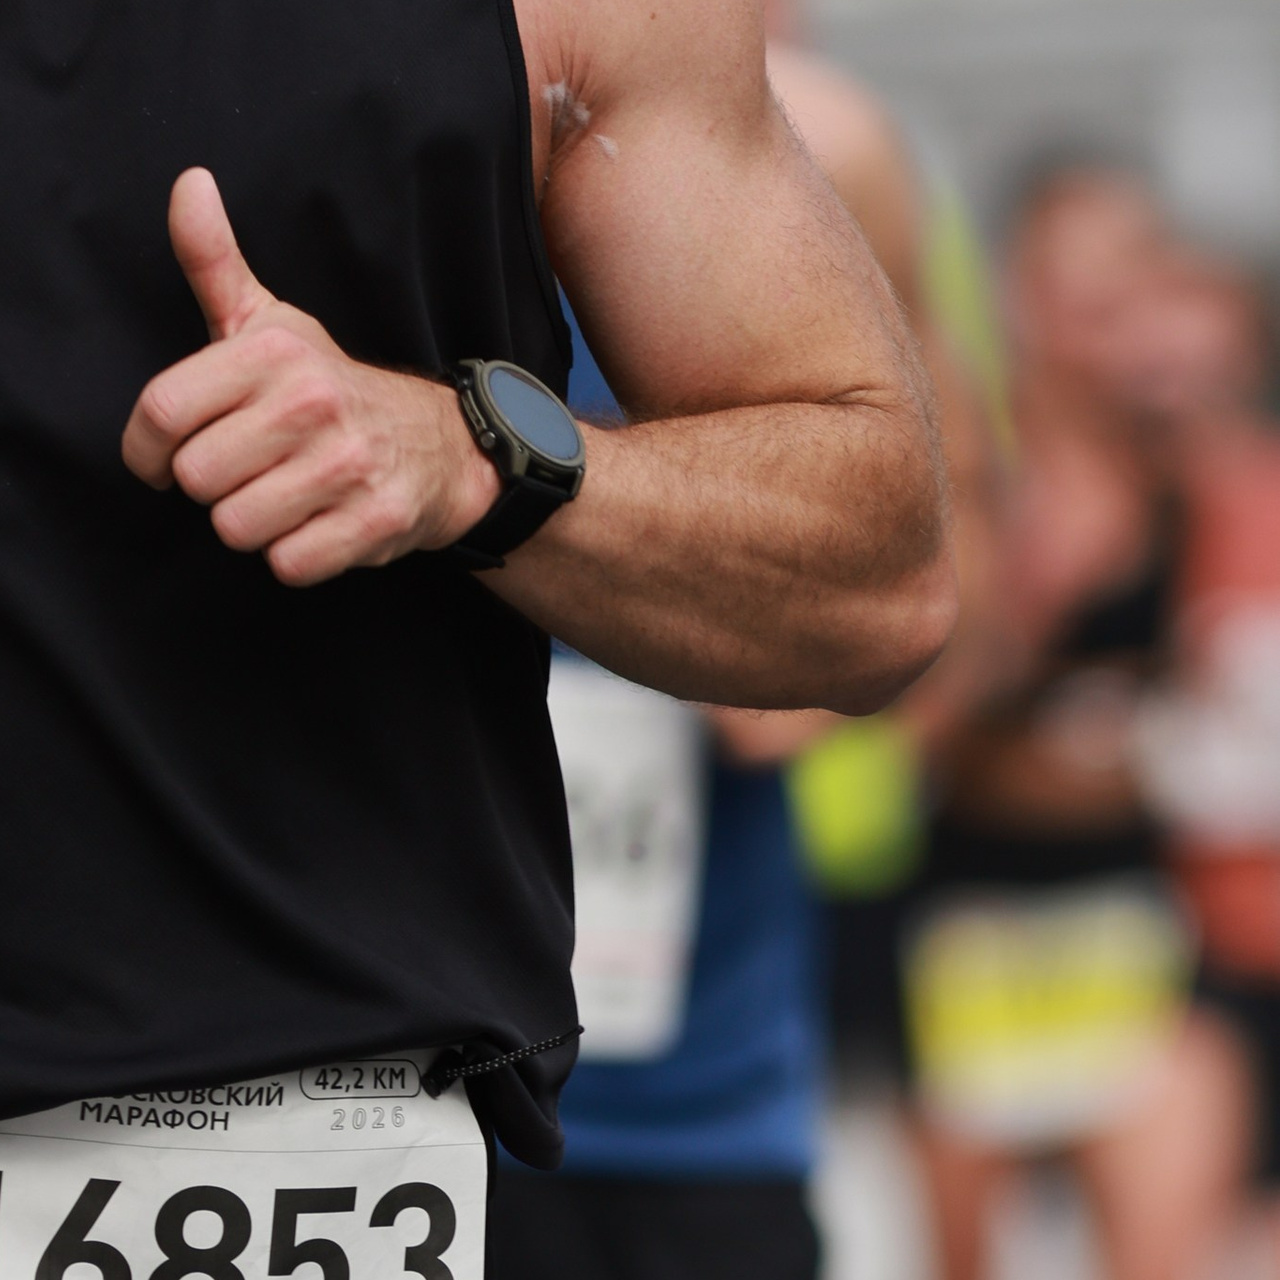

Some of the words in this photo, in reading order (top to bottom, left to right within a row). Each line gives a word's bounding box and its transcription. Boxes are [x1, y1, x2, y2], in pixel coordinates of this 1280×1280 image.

[314, 1068, 364, 1093] 42,2
[373, 1067, 406, 1090] КМ
[79, 1101, 230, 1131] МАРАФОН
[330, 1106, 405, 1130] 2026
